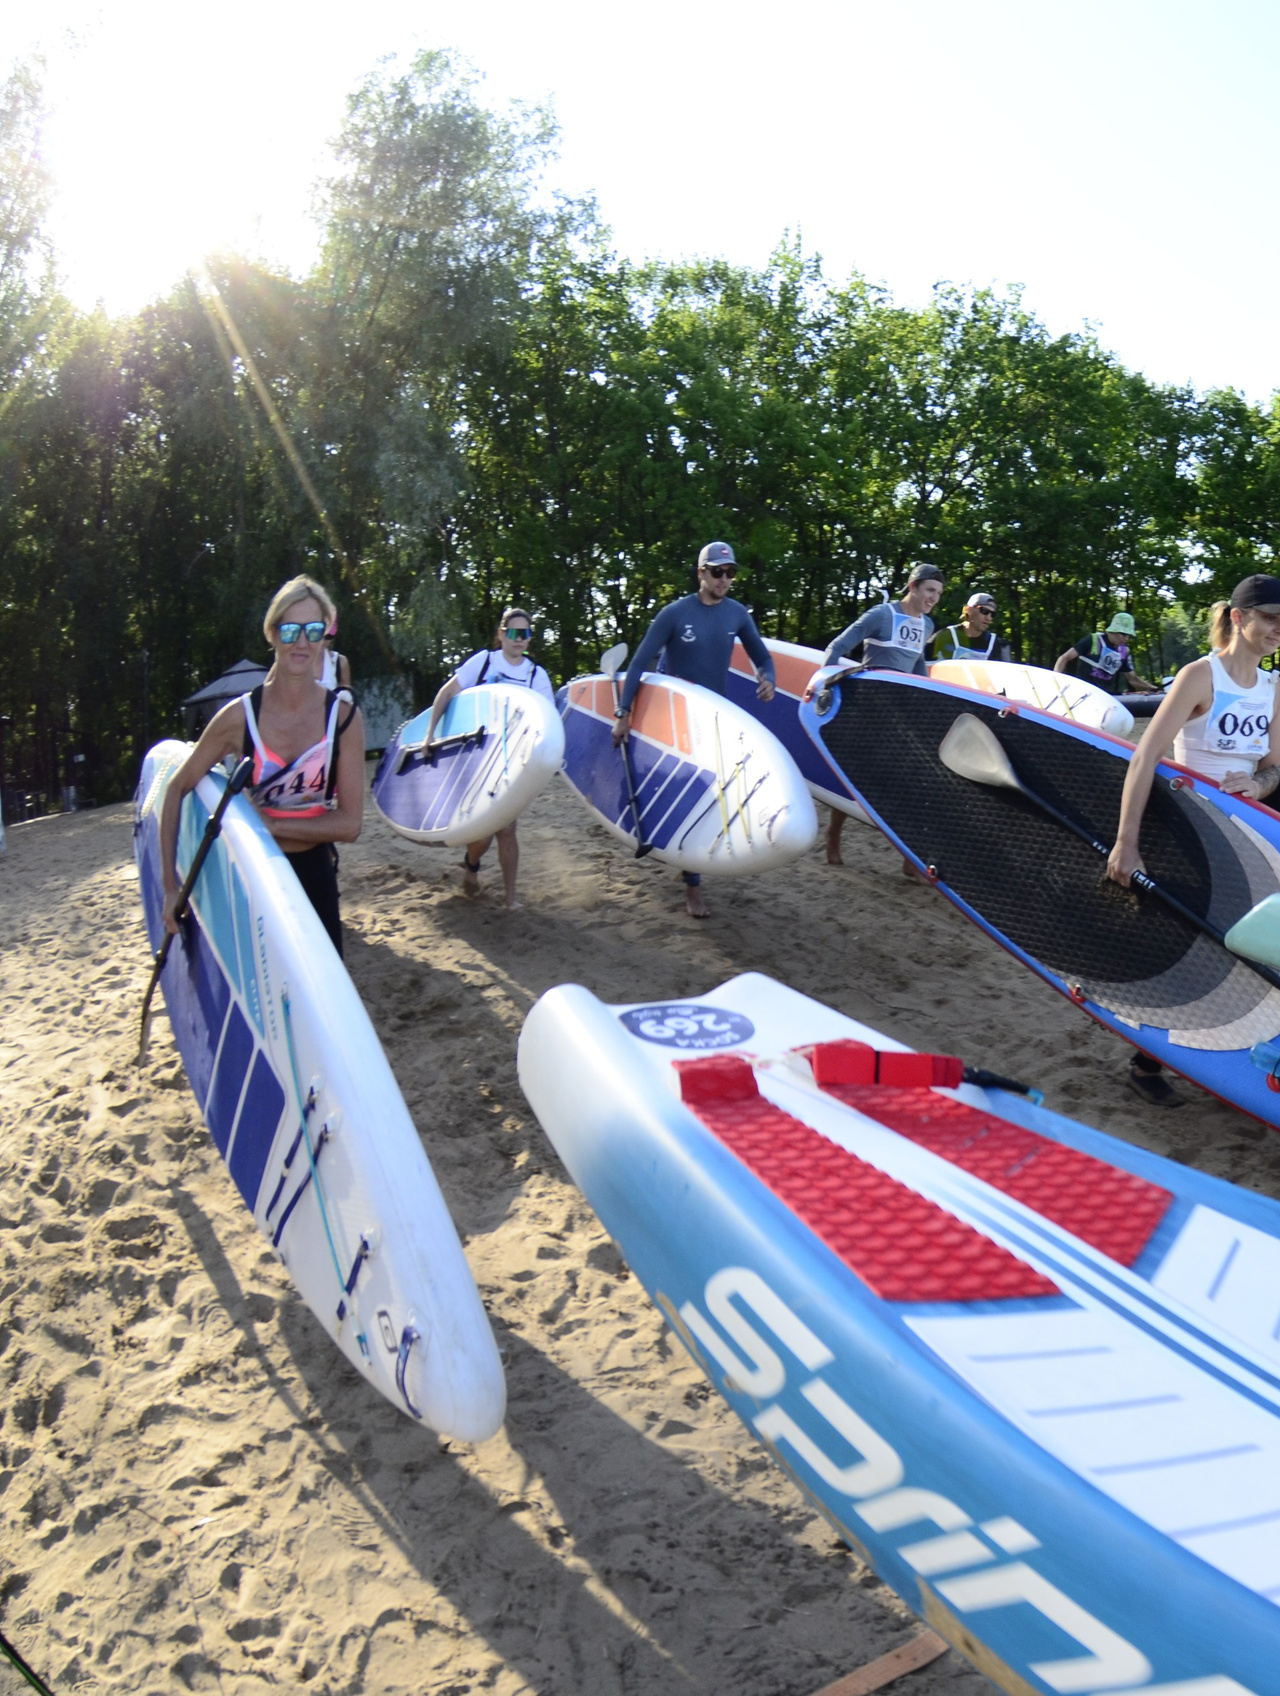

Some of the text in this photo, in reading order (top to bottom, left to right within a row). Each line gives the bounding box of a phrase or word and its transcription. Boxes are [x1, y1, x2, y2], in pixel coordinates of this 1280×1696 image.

[900, 625, 922, 643] 057
[1218, 712, 1269, 737] 069
[638, 1012, 732, 1039] 269
[679, 1266, 1258, 1696] Sprin
